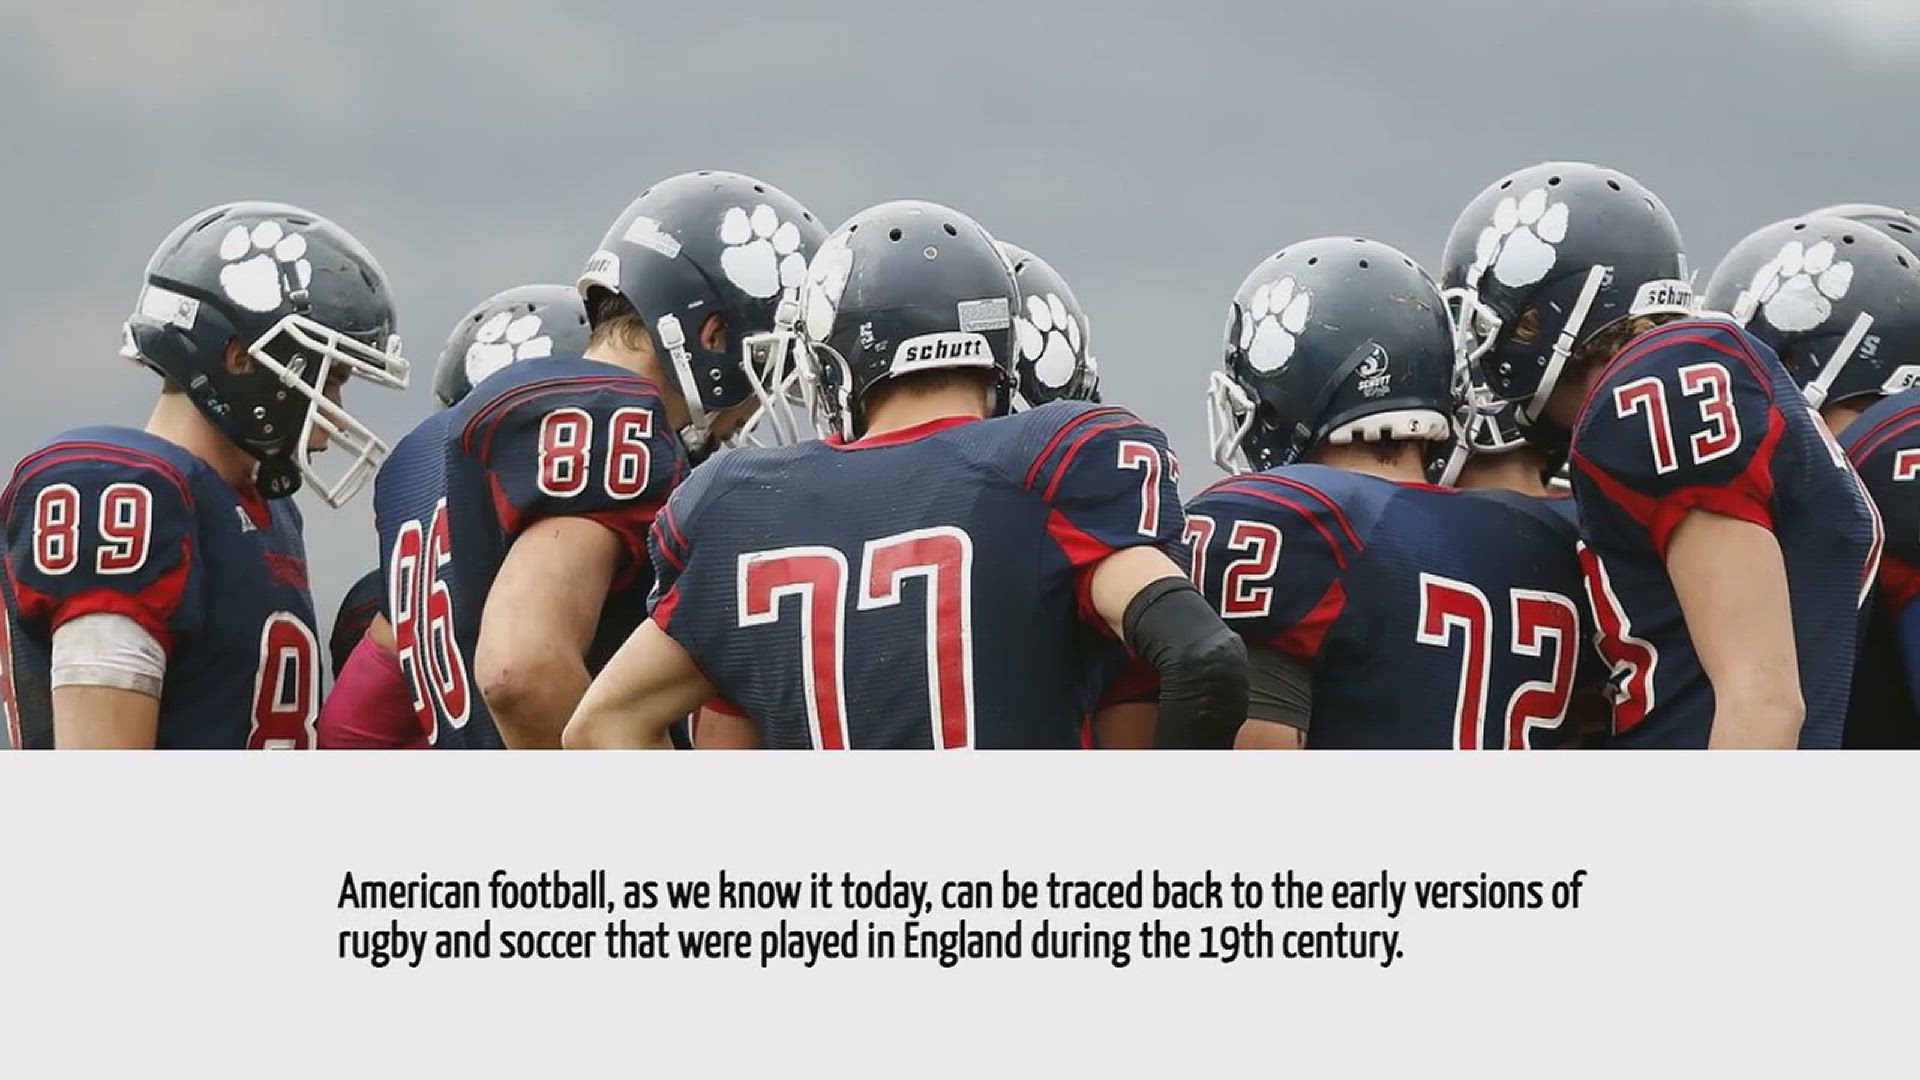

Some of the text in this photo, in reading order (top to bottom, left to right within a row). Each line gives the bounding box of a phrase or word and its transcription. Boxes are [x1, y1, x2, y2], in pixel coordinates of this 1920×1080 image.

[906, 339, 981, 362] schutt
[536, 407, 654, 500] 86
[1614, 361, 1741, 475] 73
[32, 482, 154, 576] 89
[1117, 440, 1181, 538] 7
[1182, 513, 1283, 619] 72
[389, 495, 471, 746] 86
[737, 525, 975, 750] 77
[1416, 571, 1581, 750] 72
